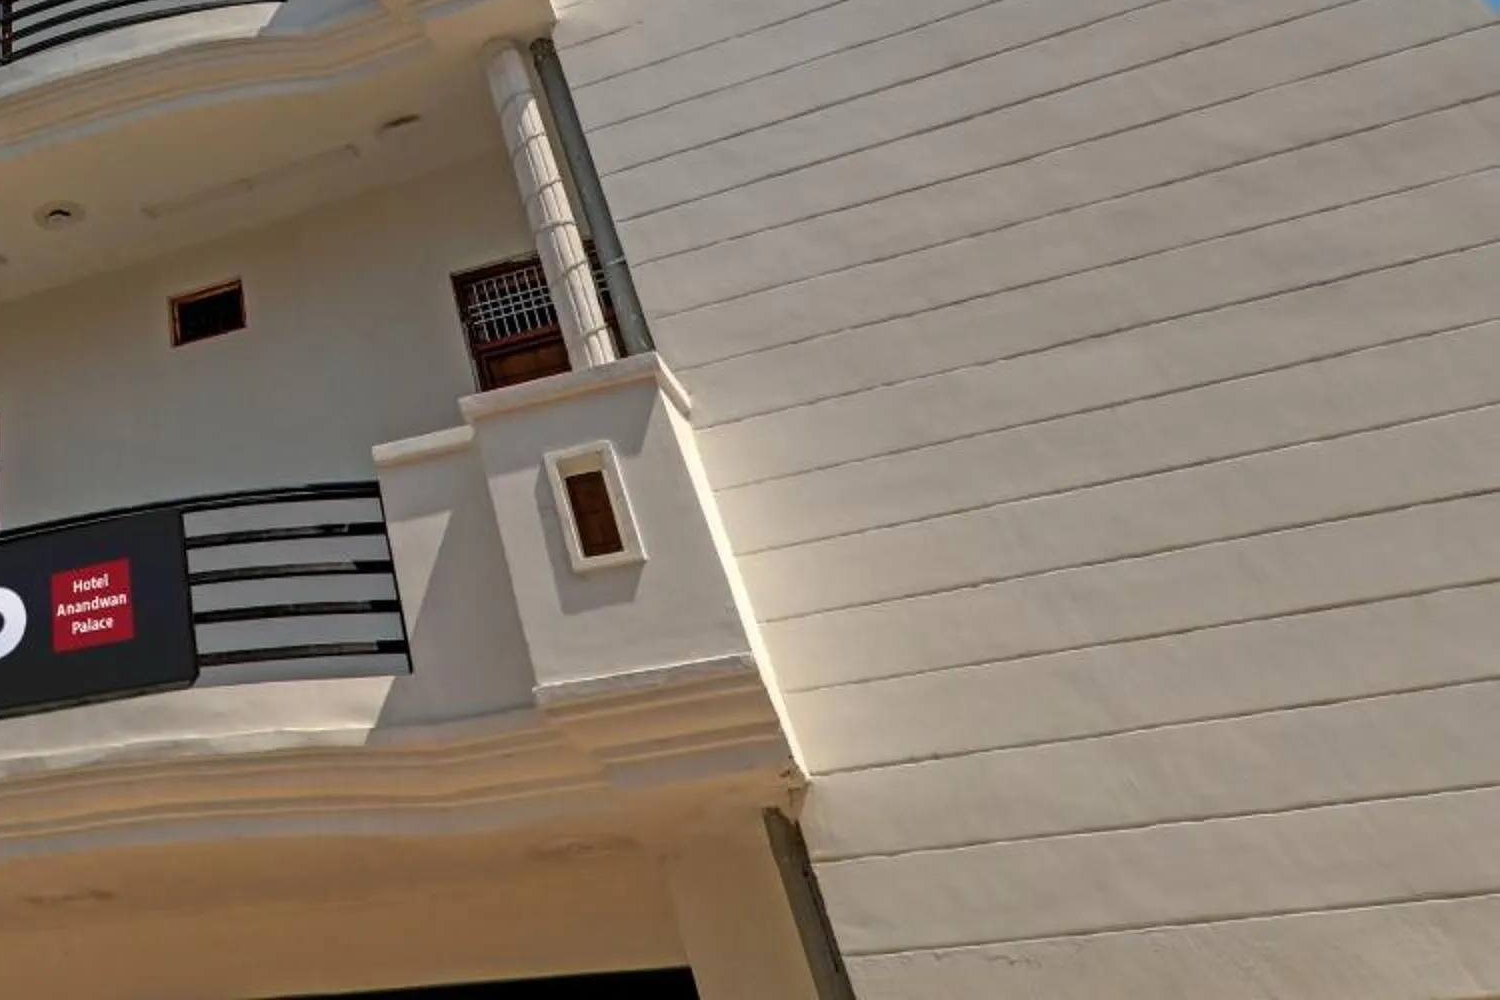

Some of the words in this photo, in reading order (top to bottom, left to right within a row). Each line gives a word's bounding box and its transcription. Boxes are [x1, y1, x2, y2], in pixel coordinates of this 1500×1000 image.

[73, 573, 109, 593] Hotel
[57, 593, 127, 617] Anandwan
[71, 616, 114, 635] Palace
